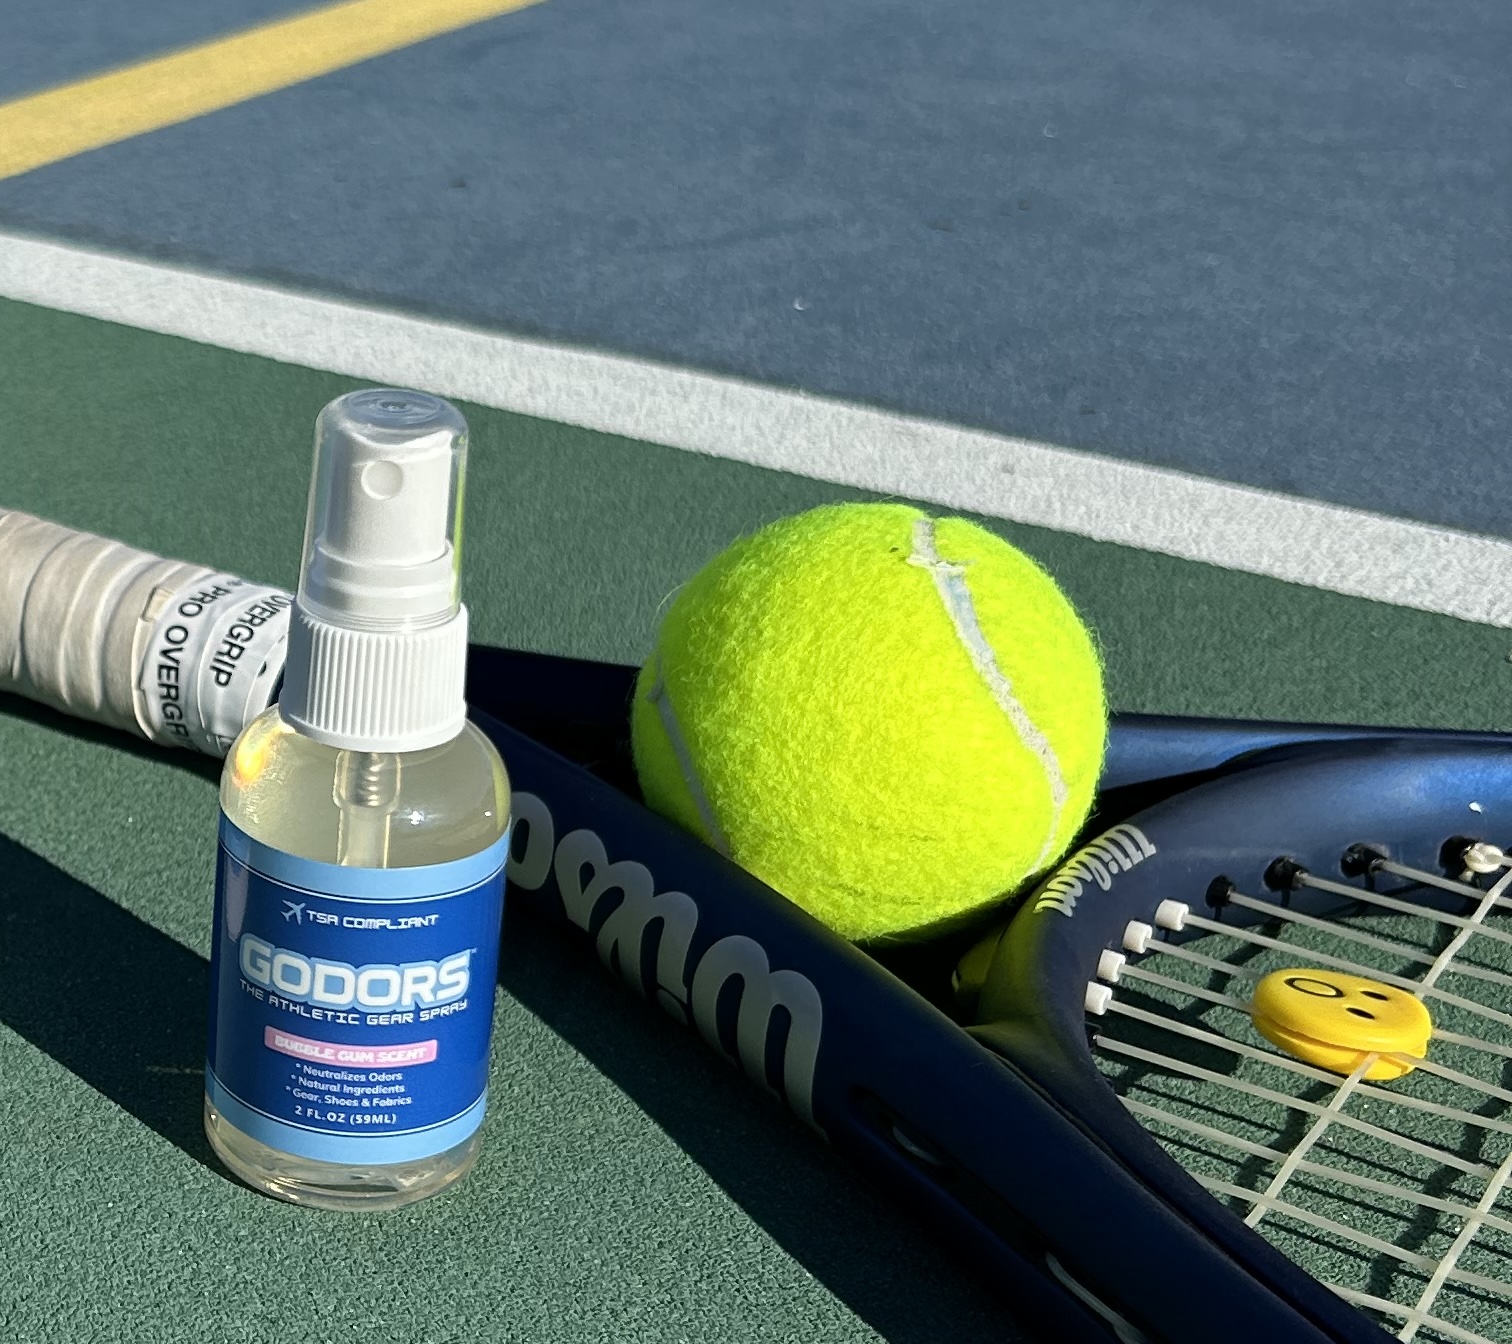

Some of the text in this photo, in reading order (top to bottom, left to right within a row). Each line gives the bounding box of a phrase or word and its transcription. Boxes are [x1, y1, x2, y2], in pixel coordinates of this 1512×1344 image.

[209, 594, 293, 688] OVERGRIP
[156, 584, 233, 741] PRO OVERGR
[1033, 822, 1157, 917] Wilson
[305, 908, 439, 931] TSA COMPLIANT
[239, 935, 472, 1010] GODORS
[507, 791, 831, 1145] Wilso
[239, 978, 469, 1026] THE ATHLETIC GEAR SPRAY
[273, 1034, 428, 1063] BUBBLE GUM SCENT
[297, 1076, 406, 1097] Natural Ingredients
[302, 1064, 404, 1083] Neutralizes Odors
[292, 1088, 413, 1107] Gear, Shoes & Fabrics
[294, 1104, 304, 1116] 2
[349, 1112, 398, 1125] (59ML)
